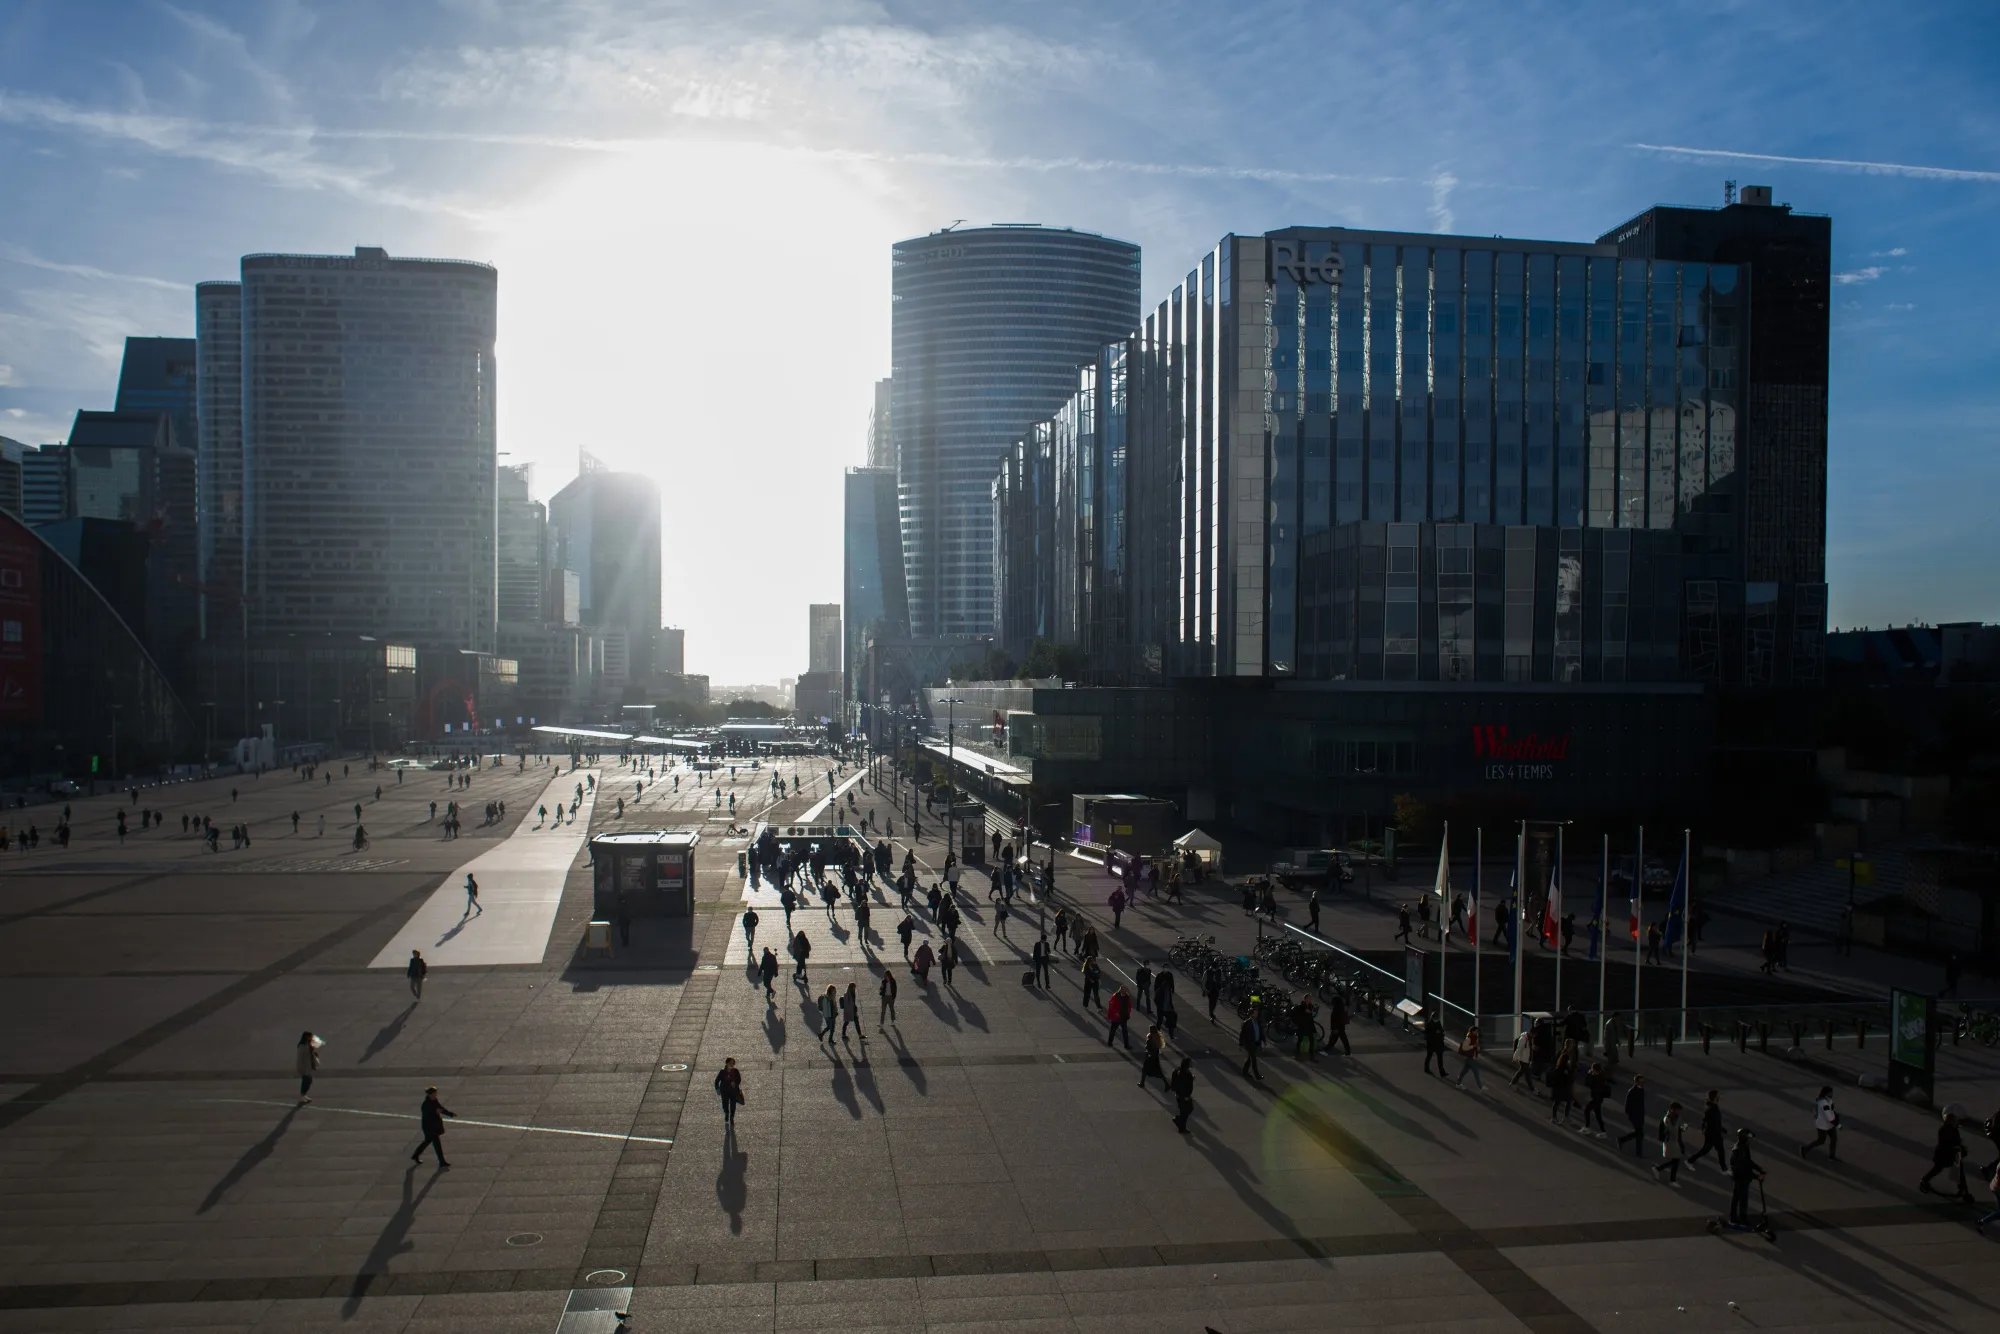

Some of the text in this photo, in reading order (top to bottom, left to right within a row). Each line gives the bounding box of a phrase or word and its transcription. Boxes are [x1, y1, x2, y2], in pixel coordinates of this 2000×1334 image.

[1471, 723, 1571, 761] Westfield
[1485, 764, 1553, 780] LES 4 TEMPS
